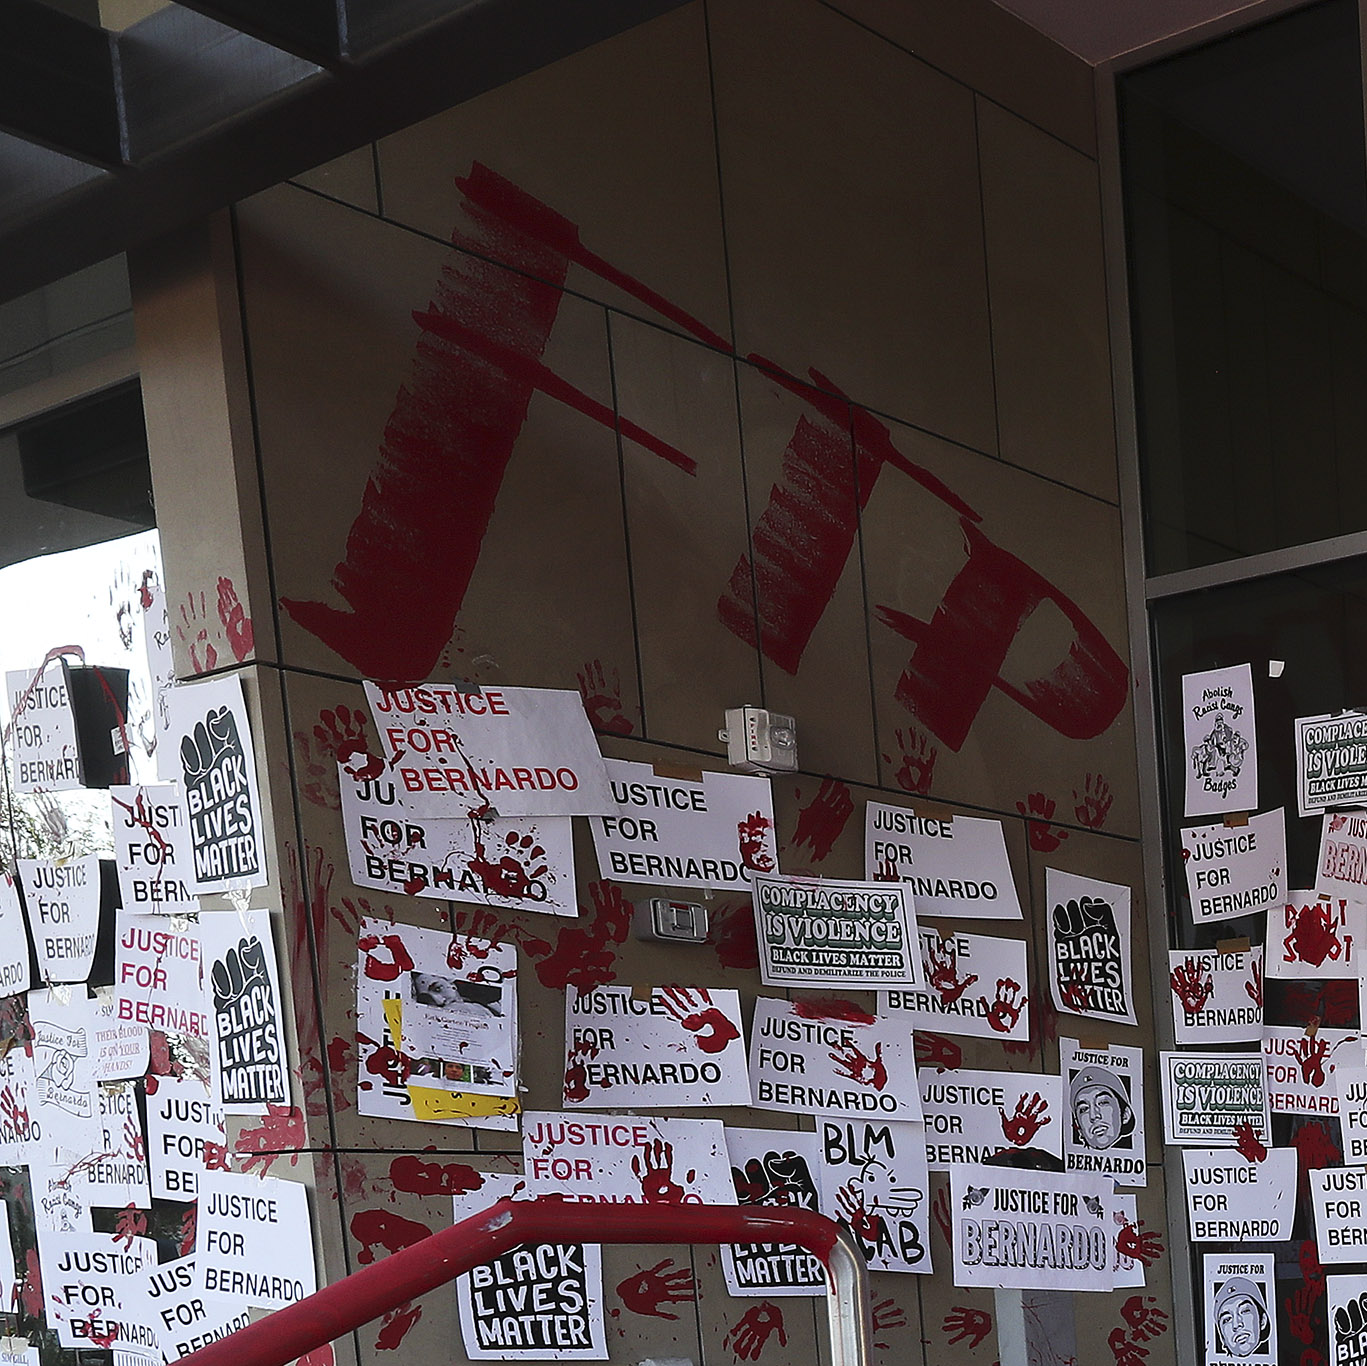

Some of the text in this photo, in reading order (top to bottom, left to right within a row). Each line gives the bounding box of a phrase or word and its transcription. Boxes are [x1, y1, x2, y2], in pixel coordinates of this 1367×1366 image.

[1202, 686, 1234, 702] Abolish
[1192, 700, 1245, 721] Racist Gangs
[388, 729, 455, 753] FOR
[1307, 751, 1323, 773] IS
[187, 755, 247, 814] BLACK
[399, 767, 579, 793] BERNARDO
[1203, 777, 1239, 801] Badges
[1310, 779, 1334, 795] BLACK
[1335, 776, 1359, 792] LIVES
[191, 796, 254, 842] LIVES
[196, 835, 258, 878] MATTER
[1196, 868, 1230, 889] FOR
[761, 885, 897, 921] COMPLACENCY
[766, 912, 902, 948] IS VIOLENCE
[772, 949, 901, 968] BLACK LIVES MATTER
[1057, 933, 1119, 961] BLACK
[771, 965, 906, 979] DEFUND AND DEMILITARIZE THE POLICE
[1058, 960, 1121, 986] LIVES
[217, 982, 275, 1035] BLACK
[220, 1025, 280, 1066] LIVES
[759, 1050, 806, 1074] FOR
[1071, 1050, 1109, 1067] JUSTICE
[223, 1062, 284, 1101] MATTER
[922, 1085, 1005, 1106] JUSTICE
[529, 1122, 649, 1147] JUSTICE
[923, 1115, 963, 1134] FOR
[823, 1122, 896, 1167] BLM
[533, 1158, 593, 1181] FOR
[1067, 1153, 1144, 1176] BERNARDO
[1190, 1166, 1258, 1186] JUSTICE
[993, 1188, 1078, 1217] JUSTICE FOR
[1193, 1194, 1227, 1212] FOR
[1325, 1200, 1361, 1219] FOR
[1195, 1220, 1280, 1239] BERNARDO
[474, 1244, 583, 1288] BLACK
[1217, 1264, 1266, 1275] JUSTICE FOR
[475, 1279, 584, 1317] LIVES
[479, 1314, 590, 1347] MATTER
